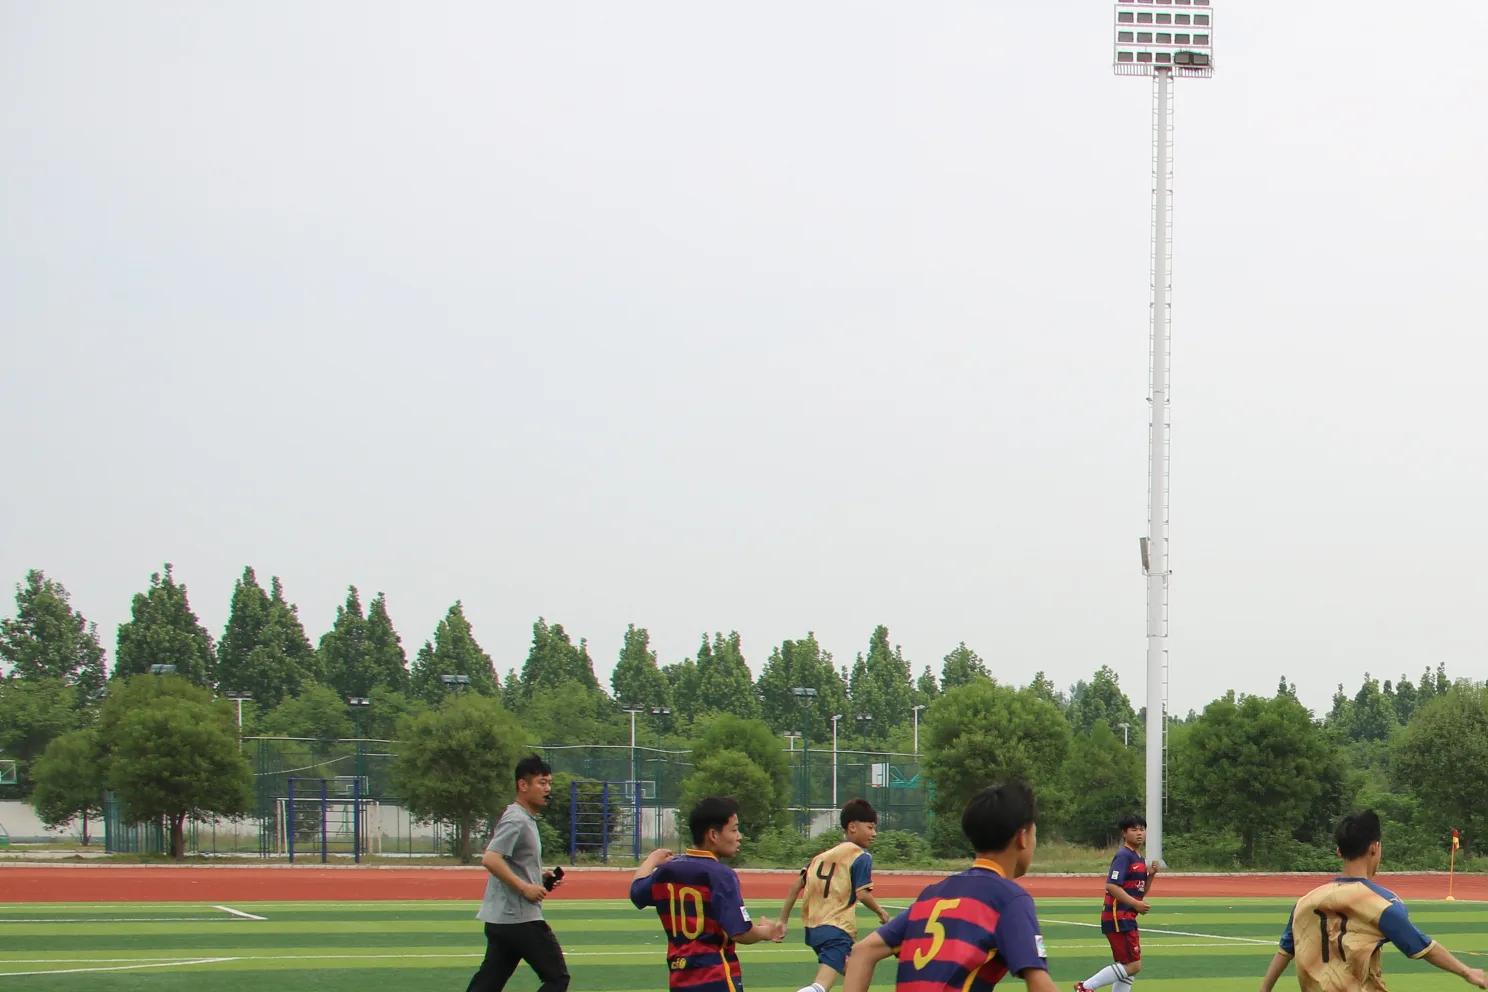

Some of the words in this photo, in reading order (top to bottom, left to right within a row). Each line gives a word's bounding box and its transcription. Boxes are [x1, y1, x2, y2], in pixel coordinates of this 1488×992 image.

[816, 861, 836, 898] 4
[667, 883, 704, 940] 10
[913, 898, 961, 970] 5
